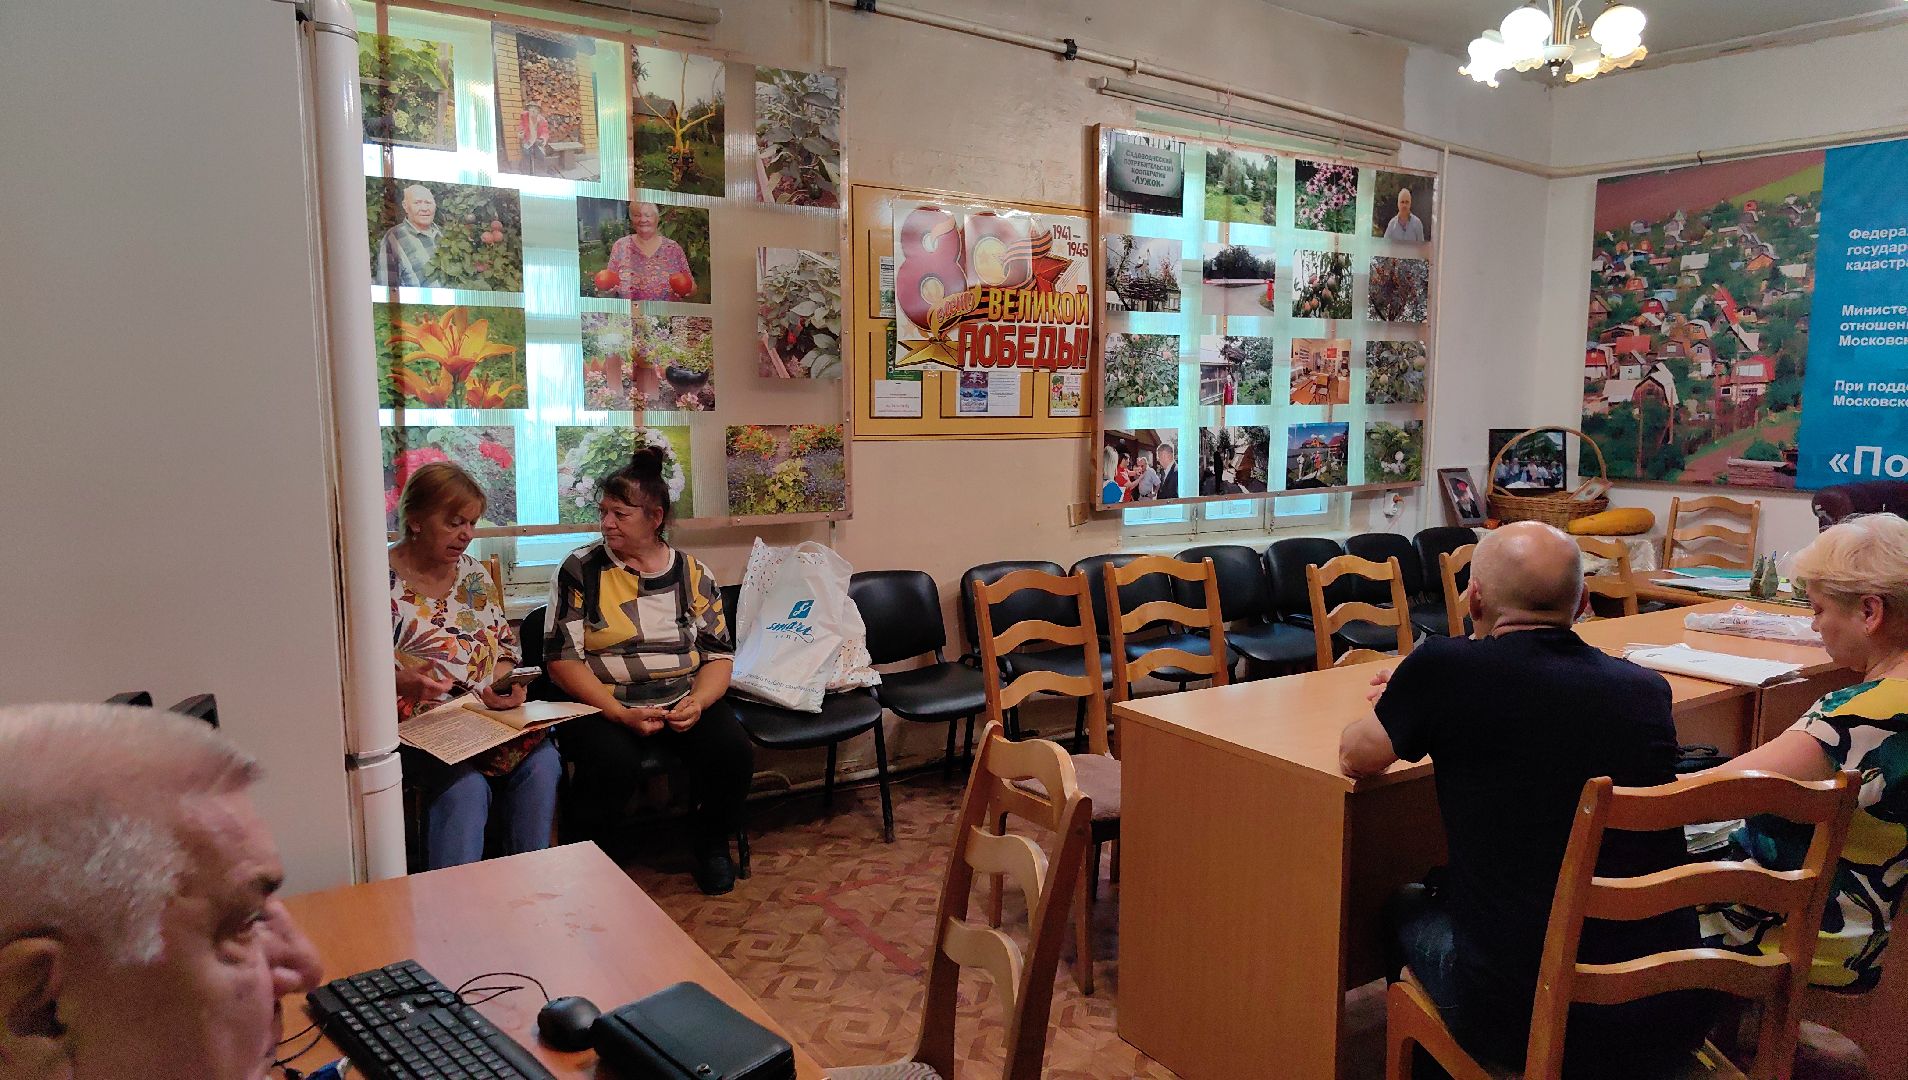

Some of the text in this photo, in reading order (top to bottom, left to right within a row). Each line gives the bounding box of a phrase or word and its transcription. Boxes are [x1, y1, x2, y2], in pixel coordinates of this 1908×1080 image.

[1849, 228, 1908, 240] Федера
[1067, 241, 1089, 257] 1945
[1847, 243, 1908, 257] государ
[1845, 259, 1908, 271] кадастр
[988, 285, 1089, 325] ВЕЛИКОЙ
[1842, 304, 1908, 316] Министе
[1840, 321, 1908, 331] отношен
[958, 323, 1089, 371] ПОБЕДЫ!
[1834, 380, 1908, 394] При подд
